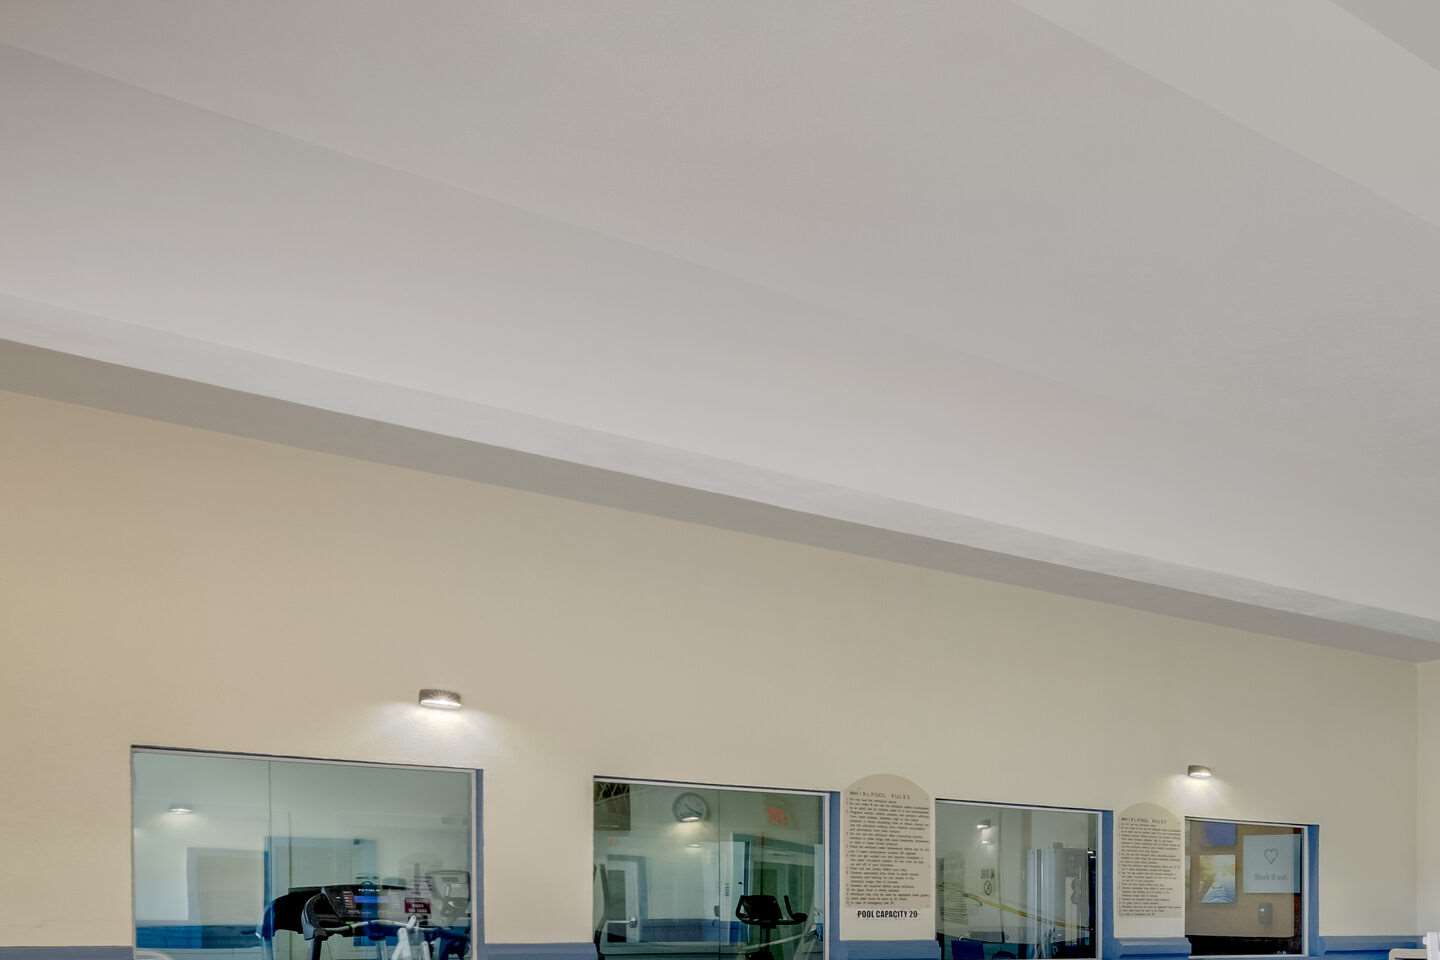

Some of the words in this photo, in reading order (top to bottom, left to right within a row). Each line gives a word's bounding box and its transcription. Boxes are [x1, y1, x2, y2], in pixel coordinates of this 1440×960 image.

[857, 910, 874, 918] POOL
[876, 910, 907, 918] CAPACITY
[909, 910, 918, 918] 20
